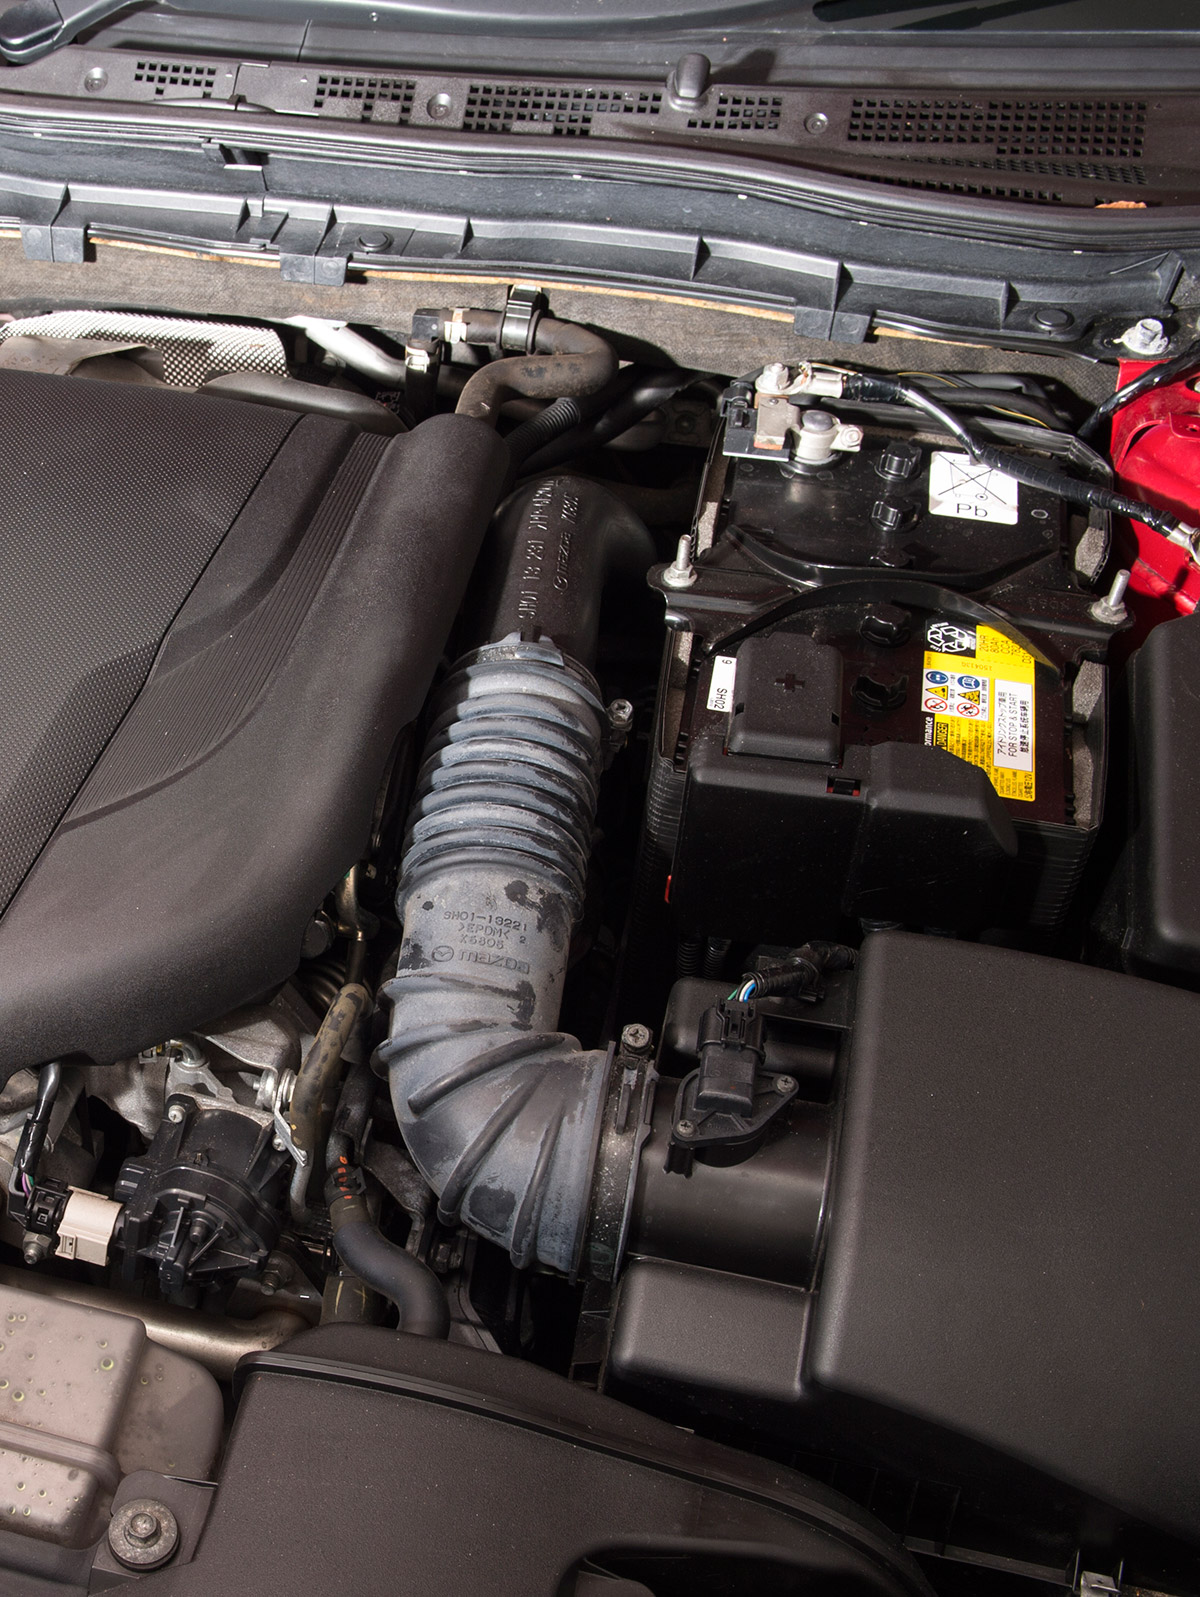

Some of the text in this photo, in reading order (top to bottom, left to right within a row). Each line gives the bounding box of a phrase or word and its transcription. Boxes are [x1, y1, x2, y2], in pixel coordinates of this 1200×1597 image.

[956, 503, 988, 518] Pb
[713, 688, 728, 709] SH02
[1009, 693, 1018, 714] START
[937, 722, 949, 747] DANGER
[1008, 721, 1018, 741] STOP
[1008, 741, 1018, 758] FOR
[519, 935, 527, 944] 2
